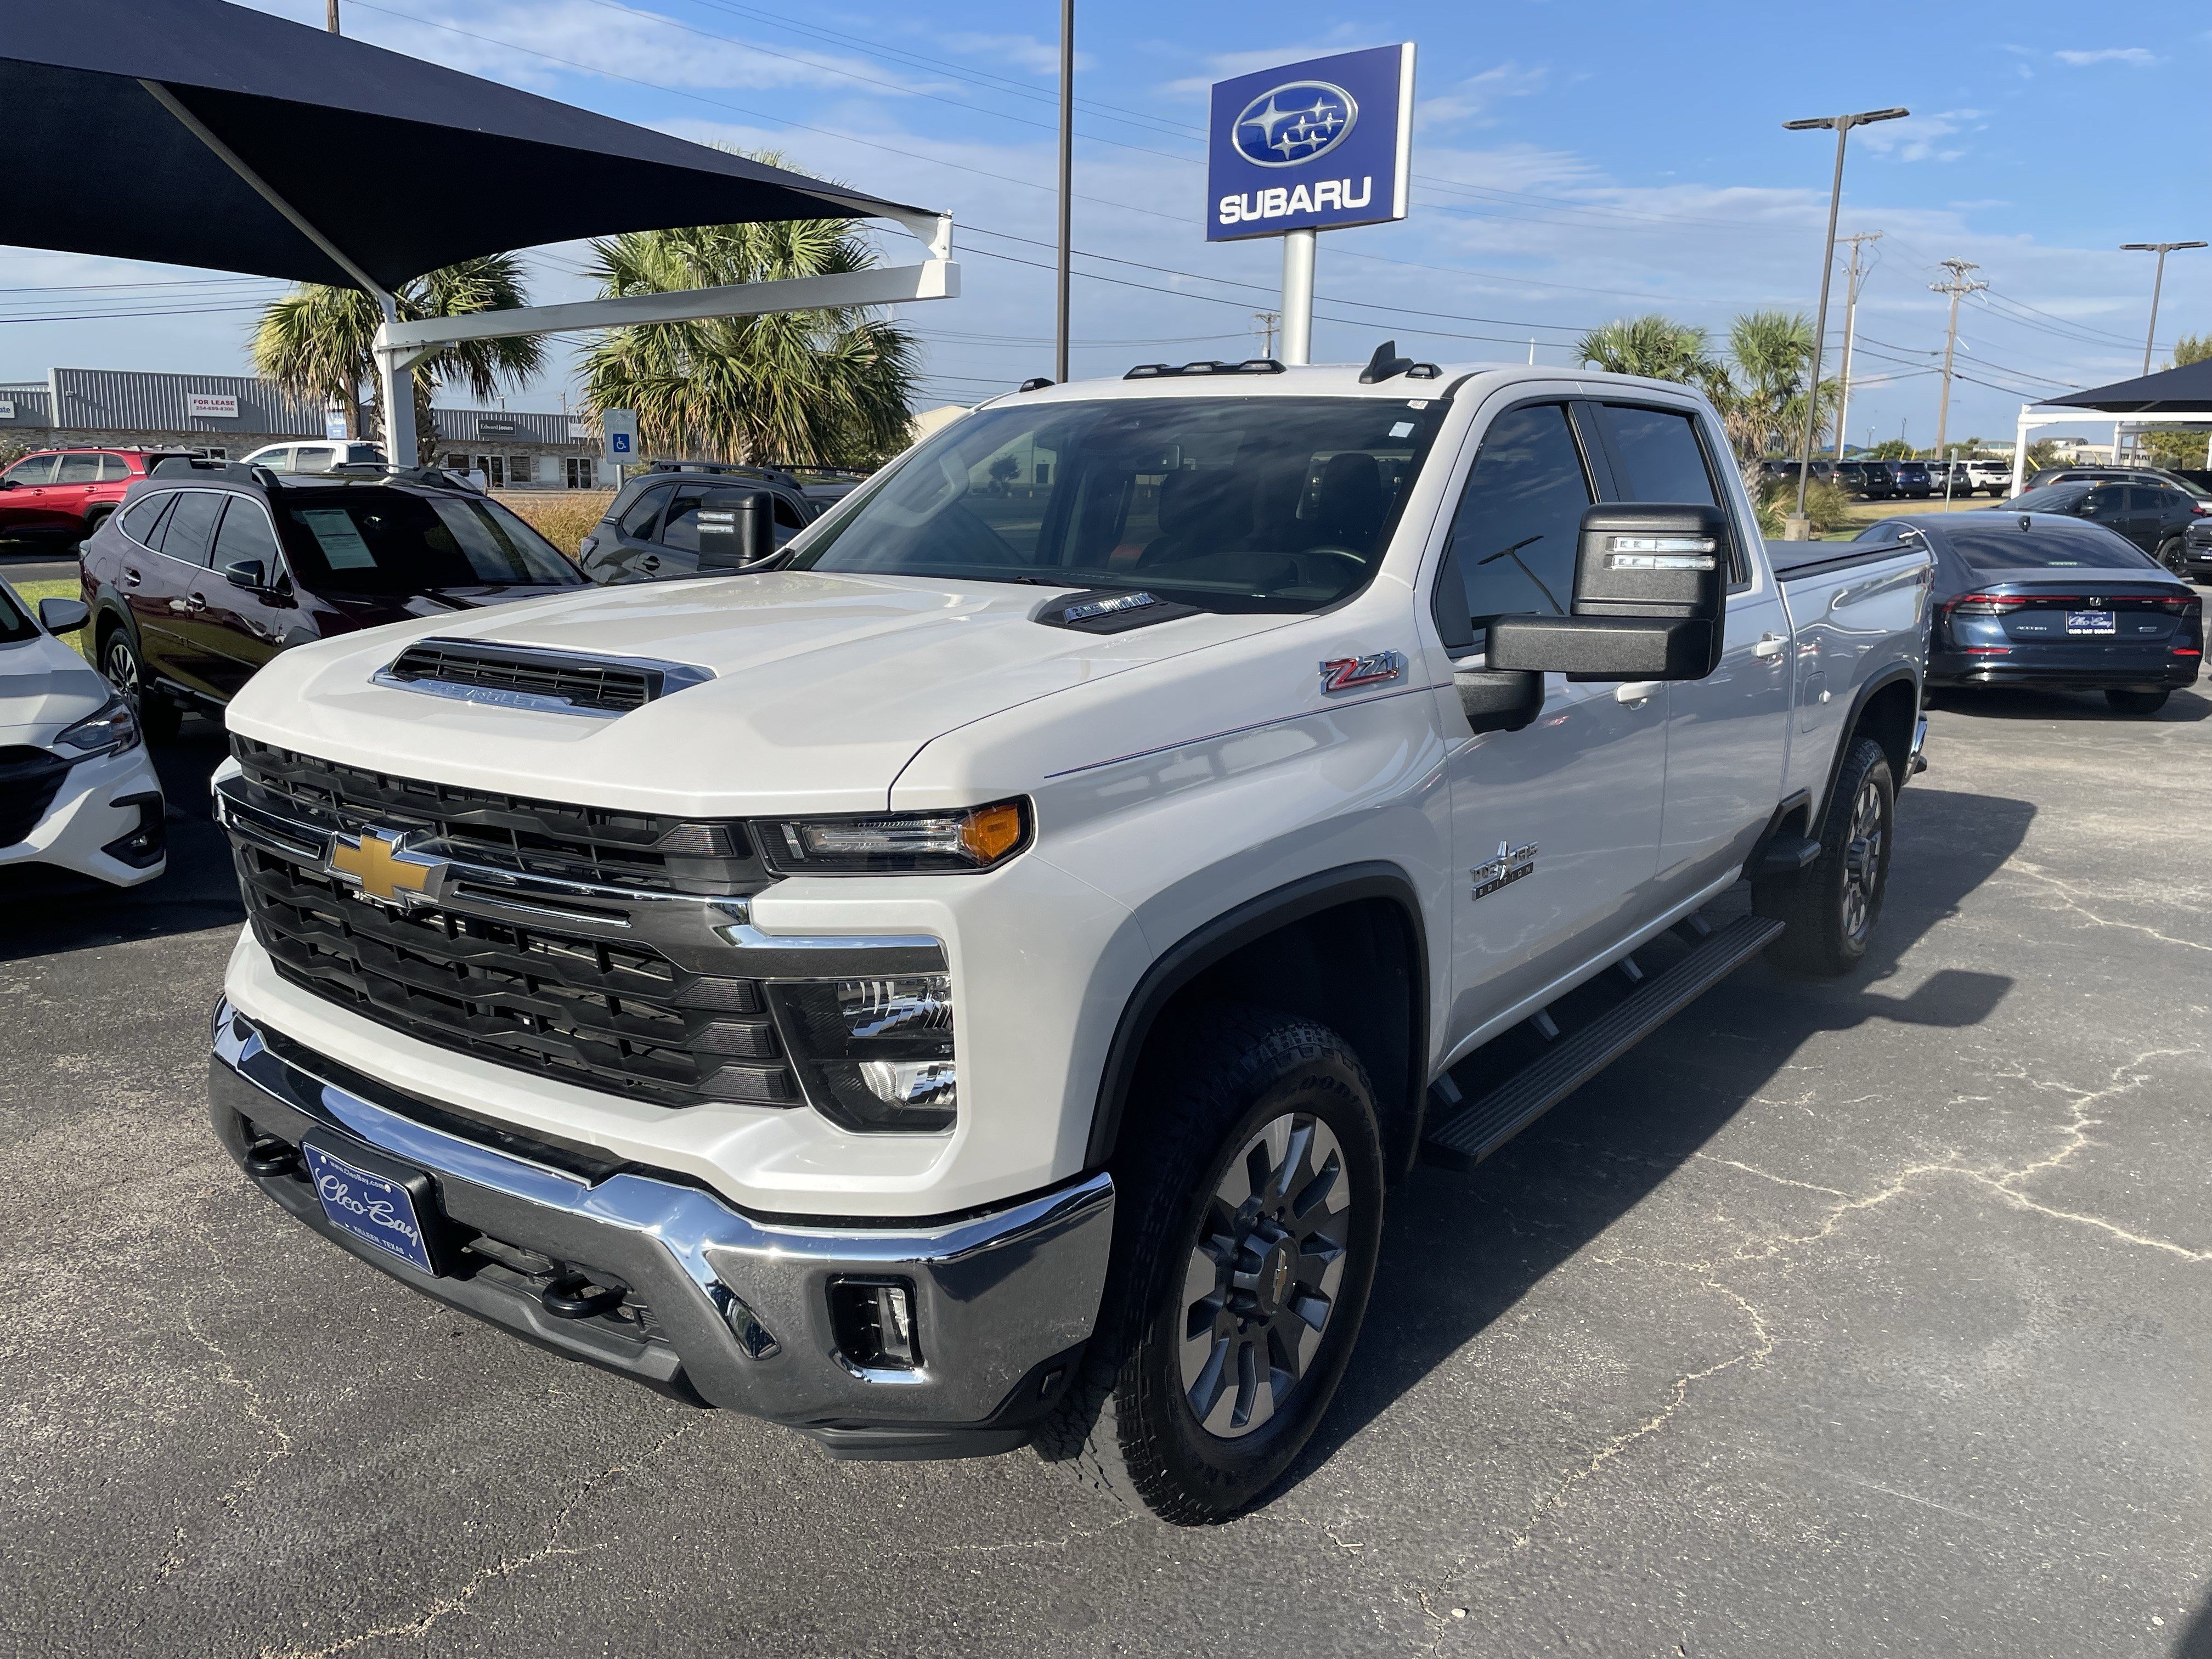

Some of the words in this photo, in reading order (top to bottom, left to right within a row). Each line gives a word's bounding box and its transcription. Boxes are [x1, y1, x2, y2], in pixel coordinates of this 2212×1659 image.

[1219, 176, 1372, 225] SUBARU
[1317, 650, 1399, 695] Z71
[425, 682, 545, 707] CHEVROLET
[1479, 865, 1531, 895] EDITION
[330, 1160, 385, 1189] www.CleoBay.com
[315, 1167, 368, 1215] Cleo
[363, 1192, 419, 1248] Bay
[353, 1224, 382, 1245] KILLEEN,
[382, 1239, 405, 1255] TEXAS
